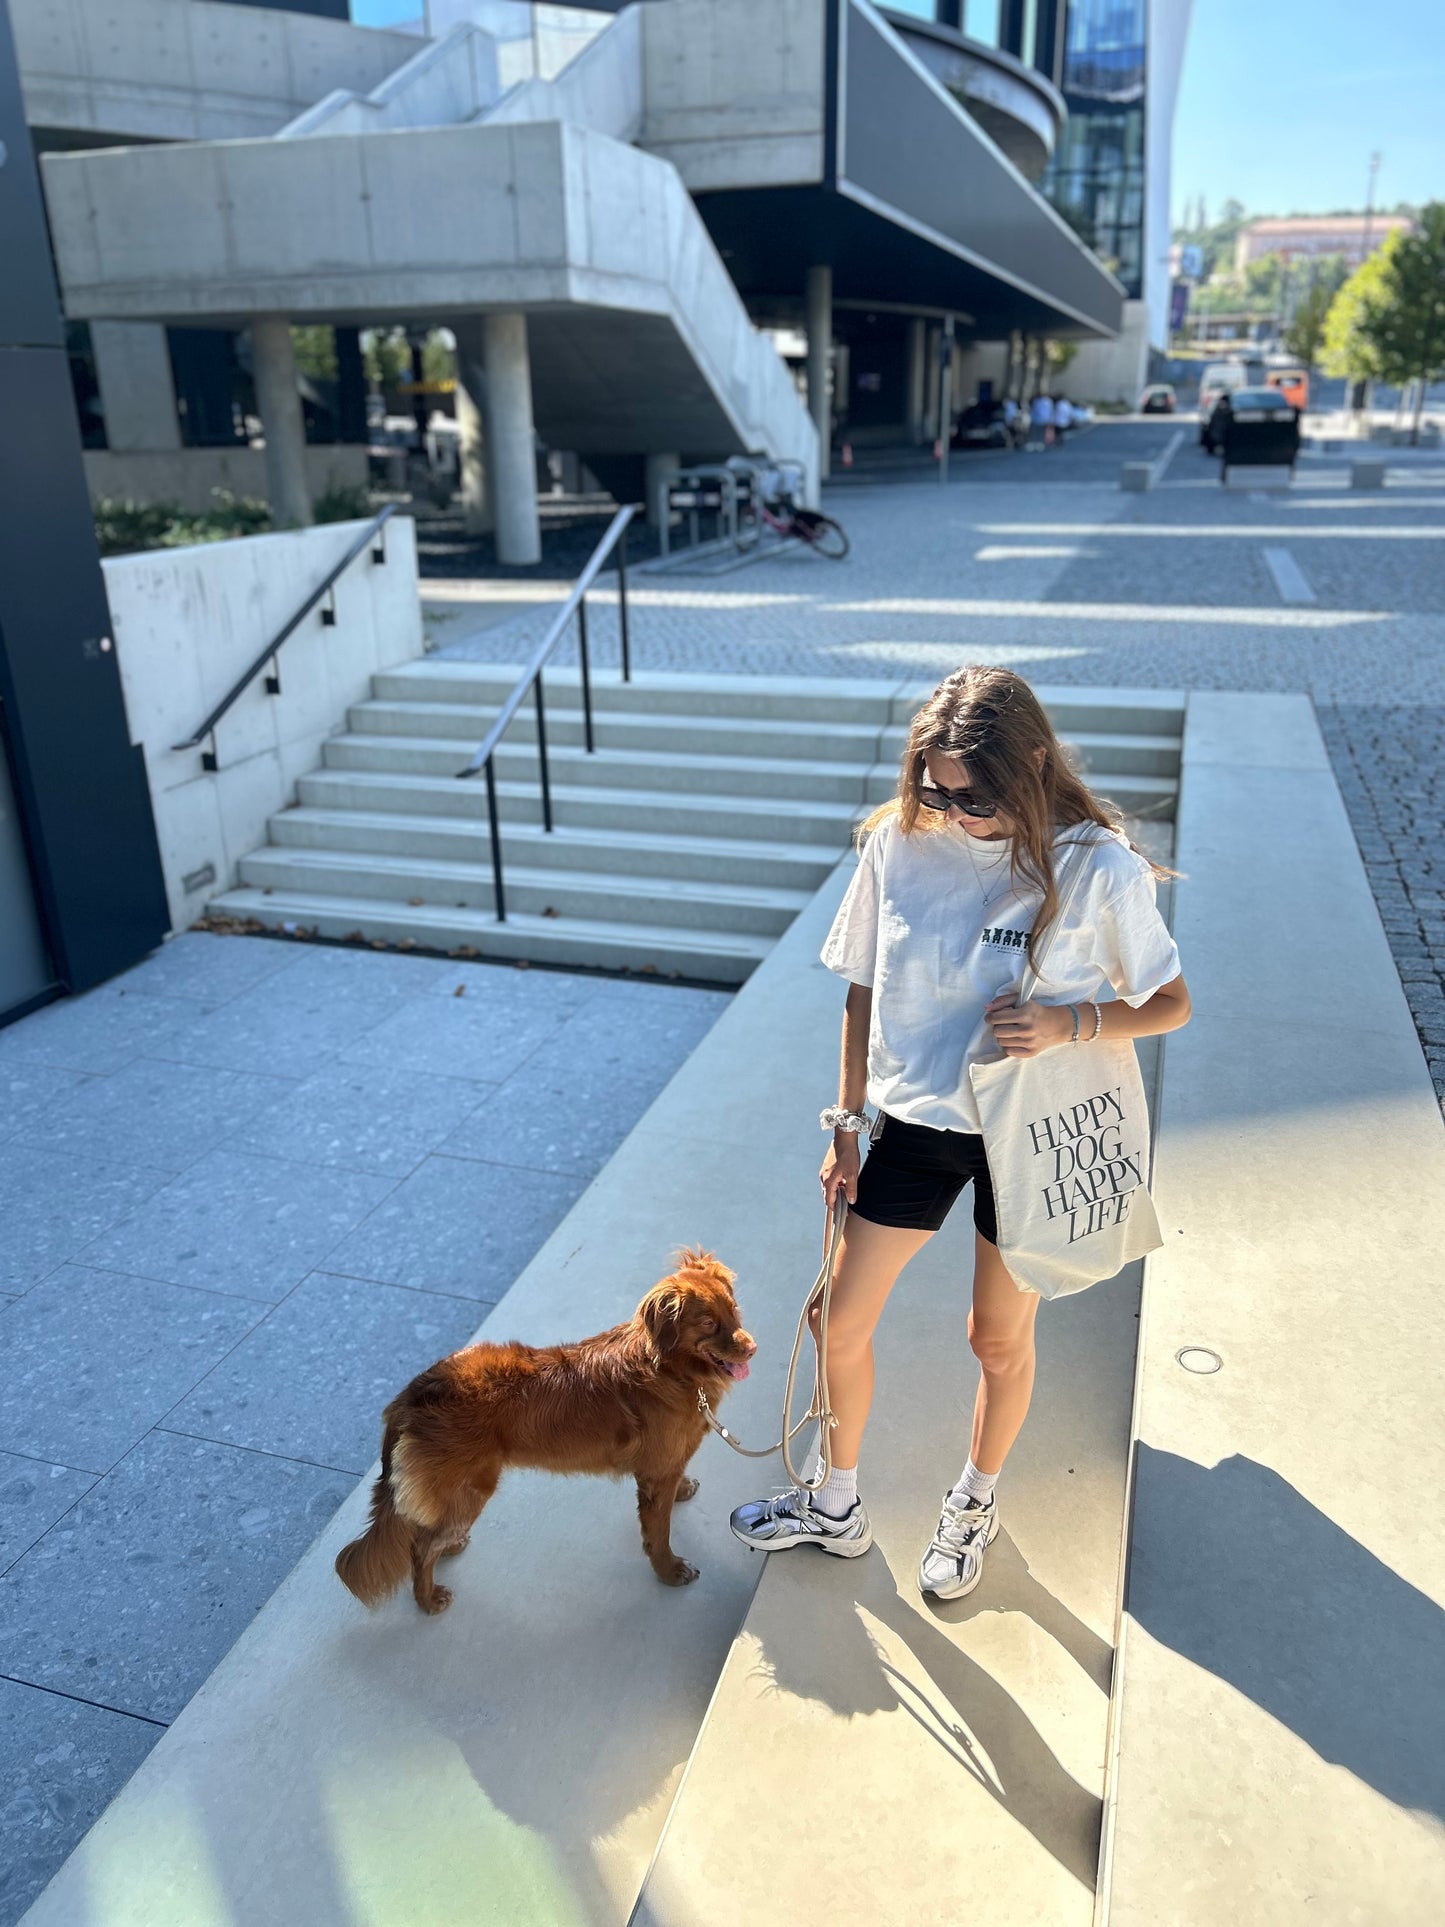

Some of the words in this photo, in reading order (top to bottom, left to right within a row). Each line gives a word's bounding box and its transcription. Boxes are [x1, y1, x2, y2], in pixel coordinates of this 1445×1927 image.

[1027, 1087, 1126, 1156] HAPPY
[1053, 1124, 1123, 1183] DOG
[1041, 1151, 1144, 1221] HAPPY
[1067, 1190, 1135, 1245] LIFE
